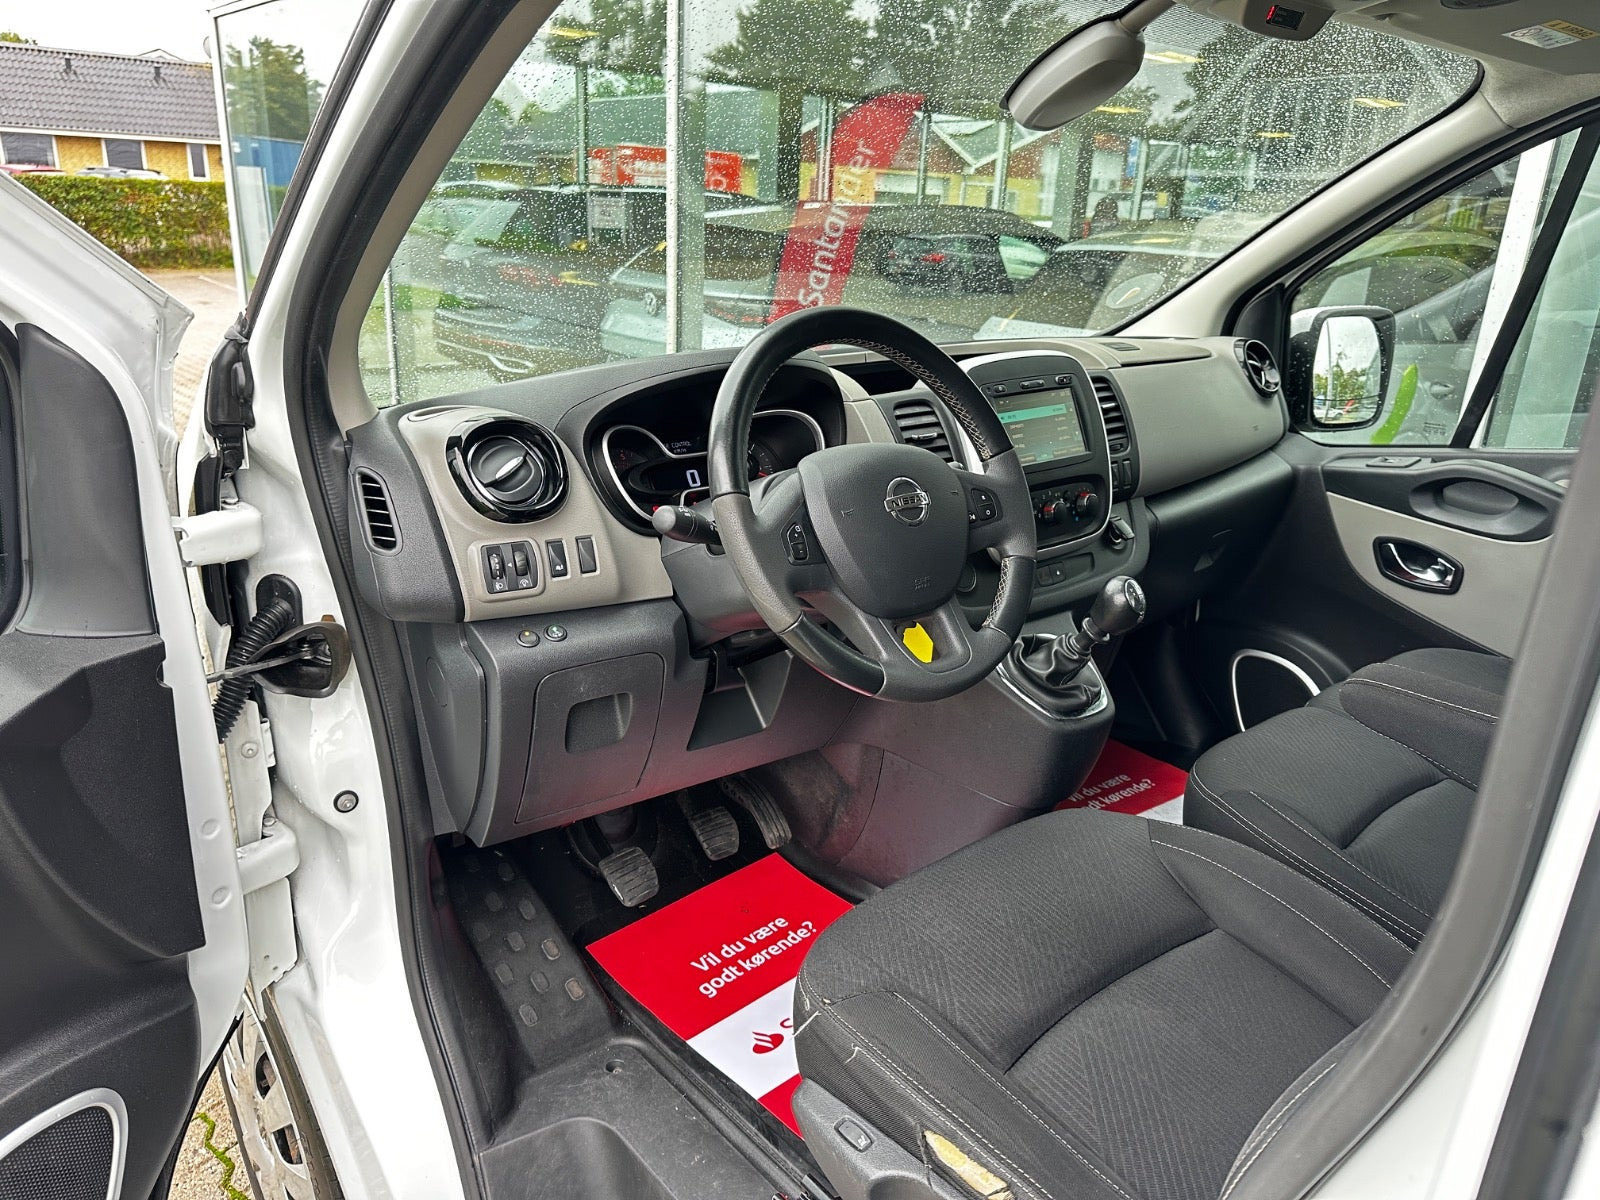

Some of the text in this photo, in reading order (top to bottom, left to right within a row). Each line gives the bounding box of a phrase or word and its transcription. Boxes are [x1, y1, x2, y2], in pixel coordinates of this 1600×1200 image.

[799, 140, 876, 307] Santander
[686, 469, 701, 487] 0
[891, 493, 928, 508] NISSAN
[1082, 786, 1101, 797] du
[1098, 774, 1132, 789] være
[1097, 778, 1156, 804] kørende?
[690, 917, 789, 971] Vil du være
[698, 920, 817, 998] godt kørende?
